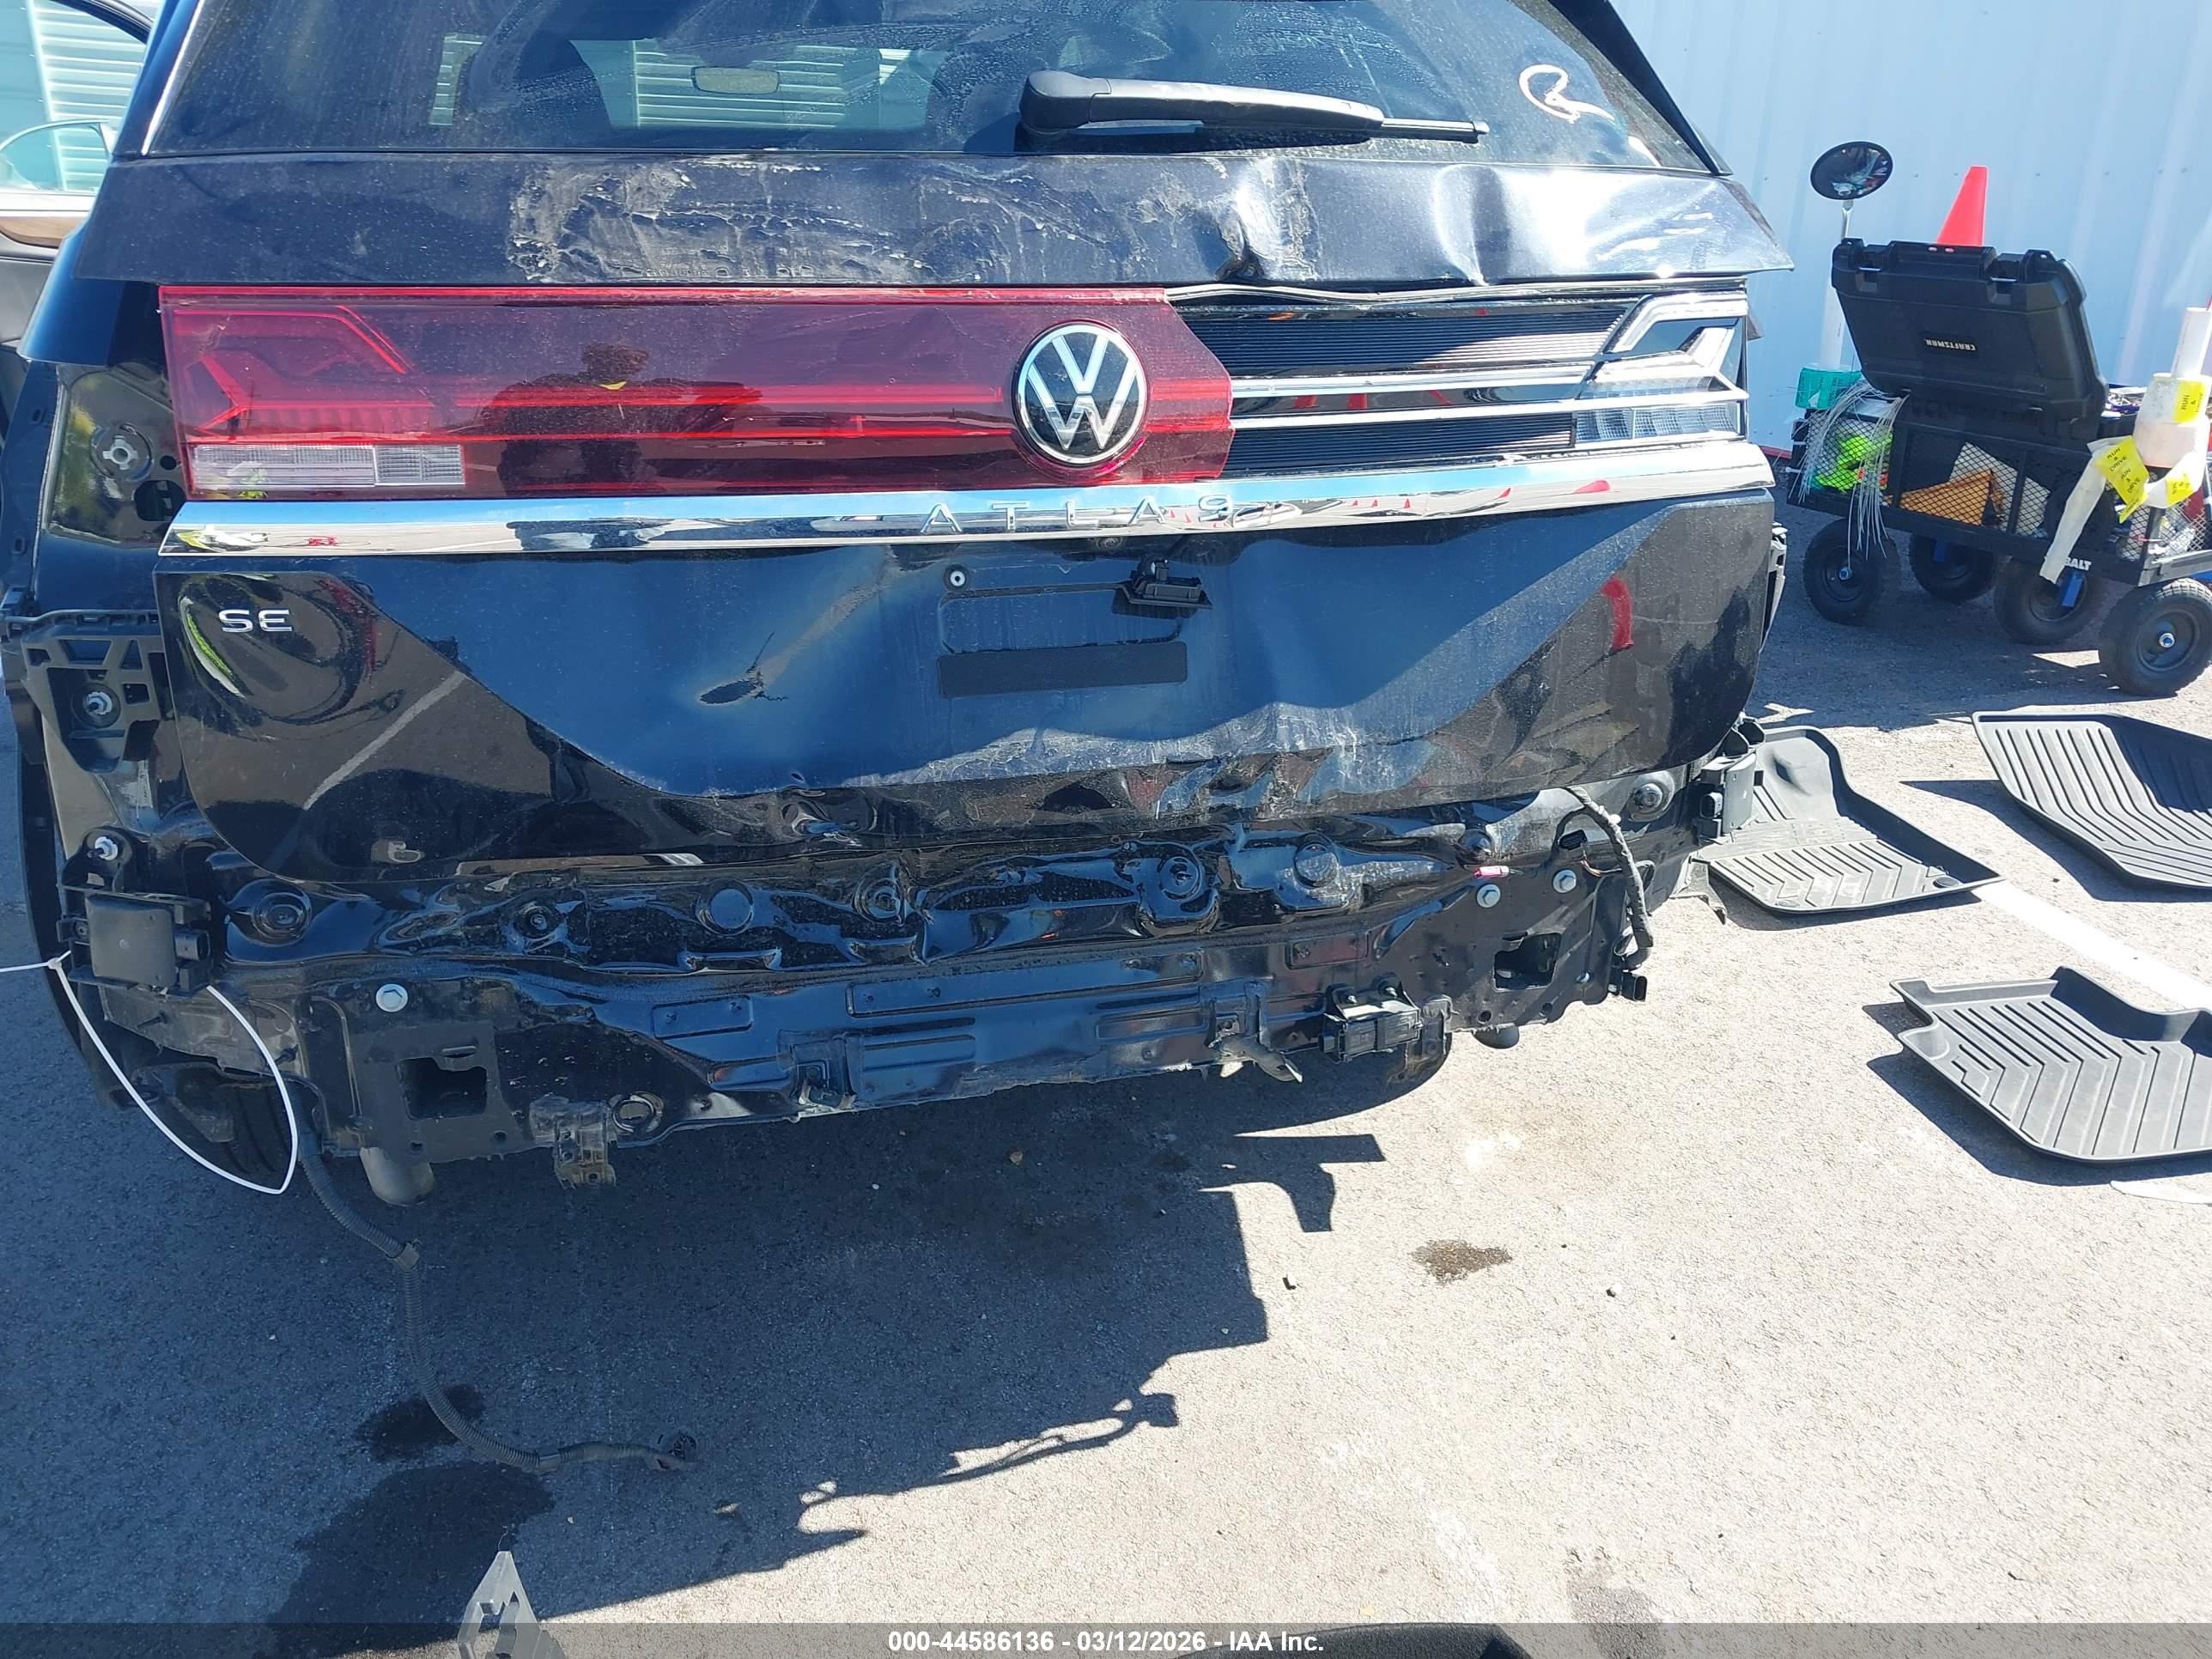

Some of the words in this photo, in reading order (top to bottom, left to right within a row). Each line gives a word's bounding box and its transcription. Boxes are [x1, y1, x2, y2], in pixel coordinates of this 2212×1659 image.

[1924, 338, 1977, 351] CRAFTSMAN
[920, 494, 1234, 534] ATLAS
[219, 609, 293, 633] SE
